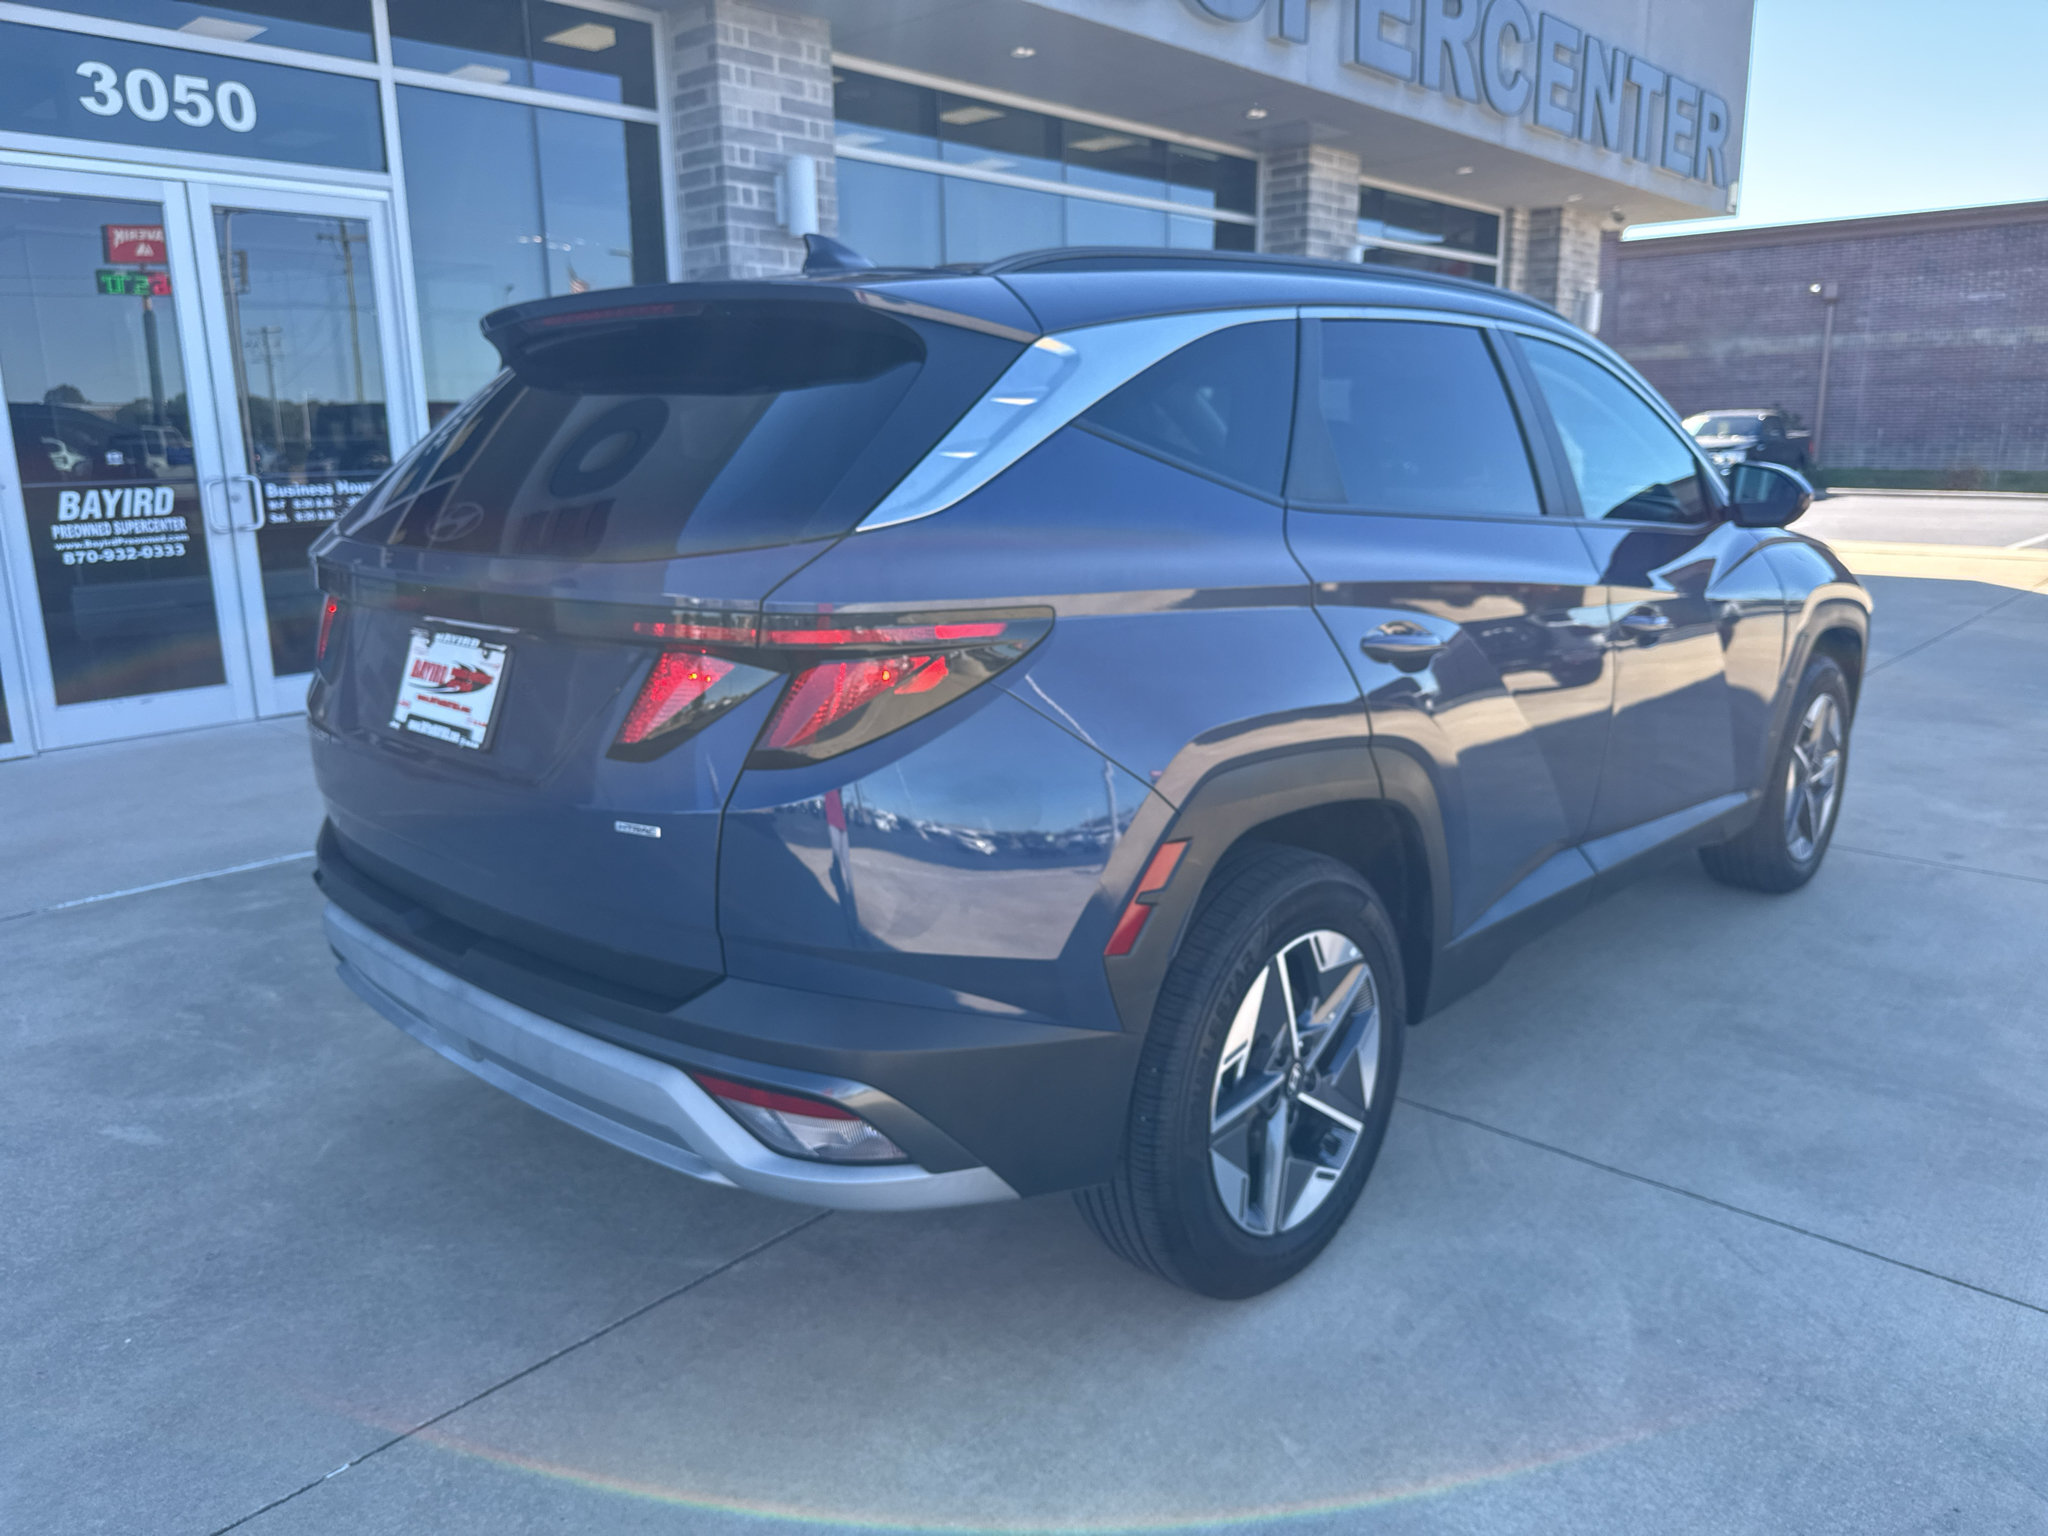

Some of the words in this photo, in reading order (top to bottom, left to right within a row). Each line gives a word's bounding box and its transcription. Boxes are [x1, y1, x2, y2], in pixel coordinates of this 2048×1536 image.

[76, 61, 257, 132] 3050
[1184, 0, 1732, 190] ERCENTER
[57, 486, 175, 521] BAYIRD
[265, 482, 334, 498] Business
[335, 480, 375, 495] Hour
[50, 521, 112, 540] PREOWNED
[112, 516, 187, 536] SUPERCENTER
[62, 542, 186, 565] 870-932-0333
